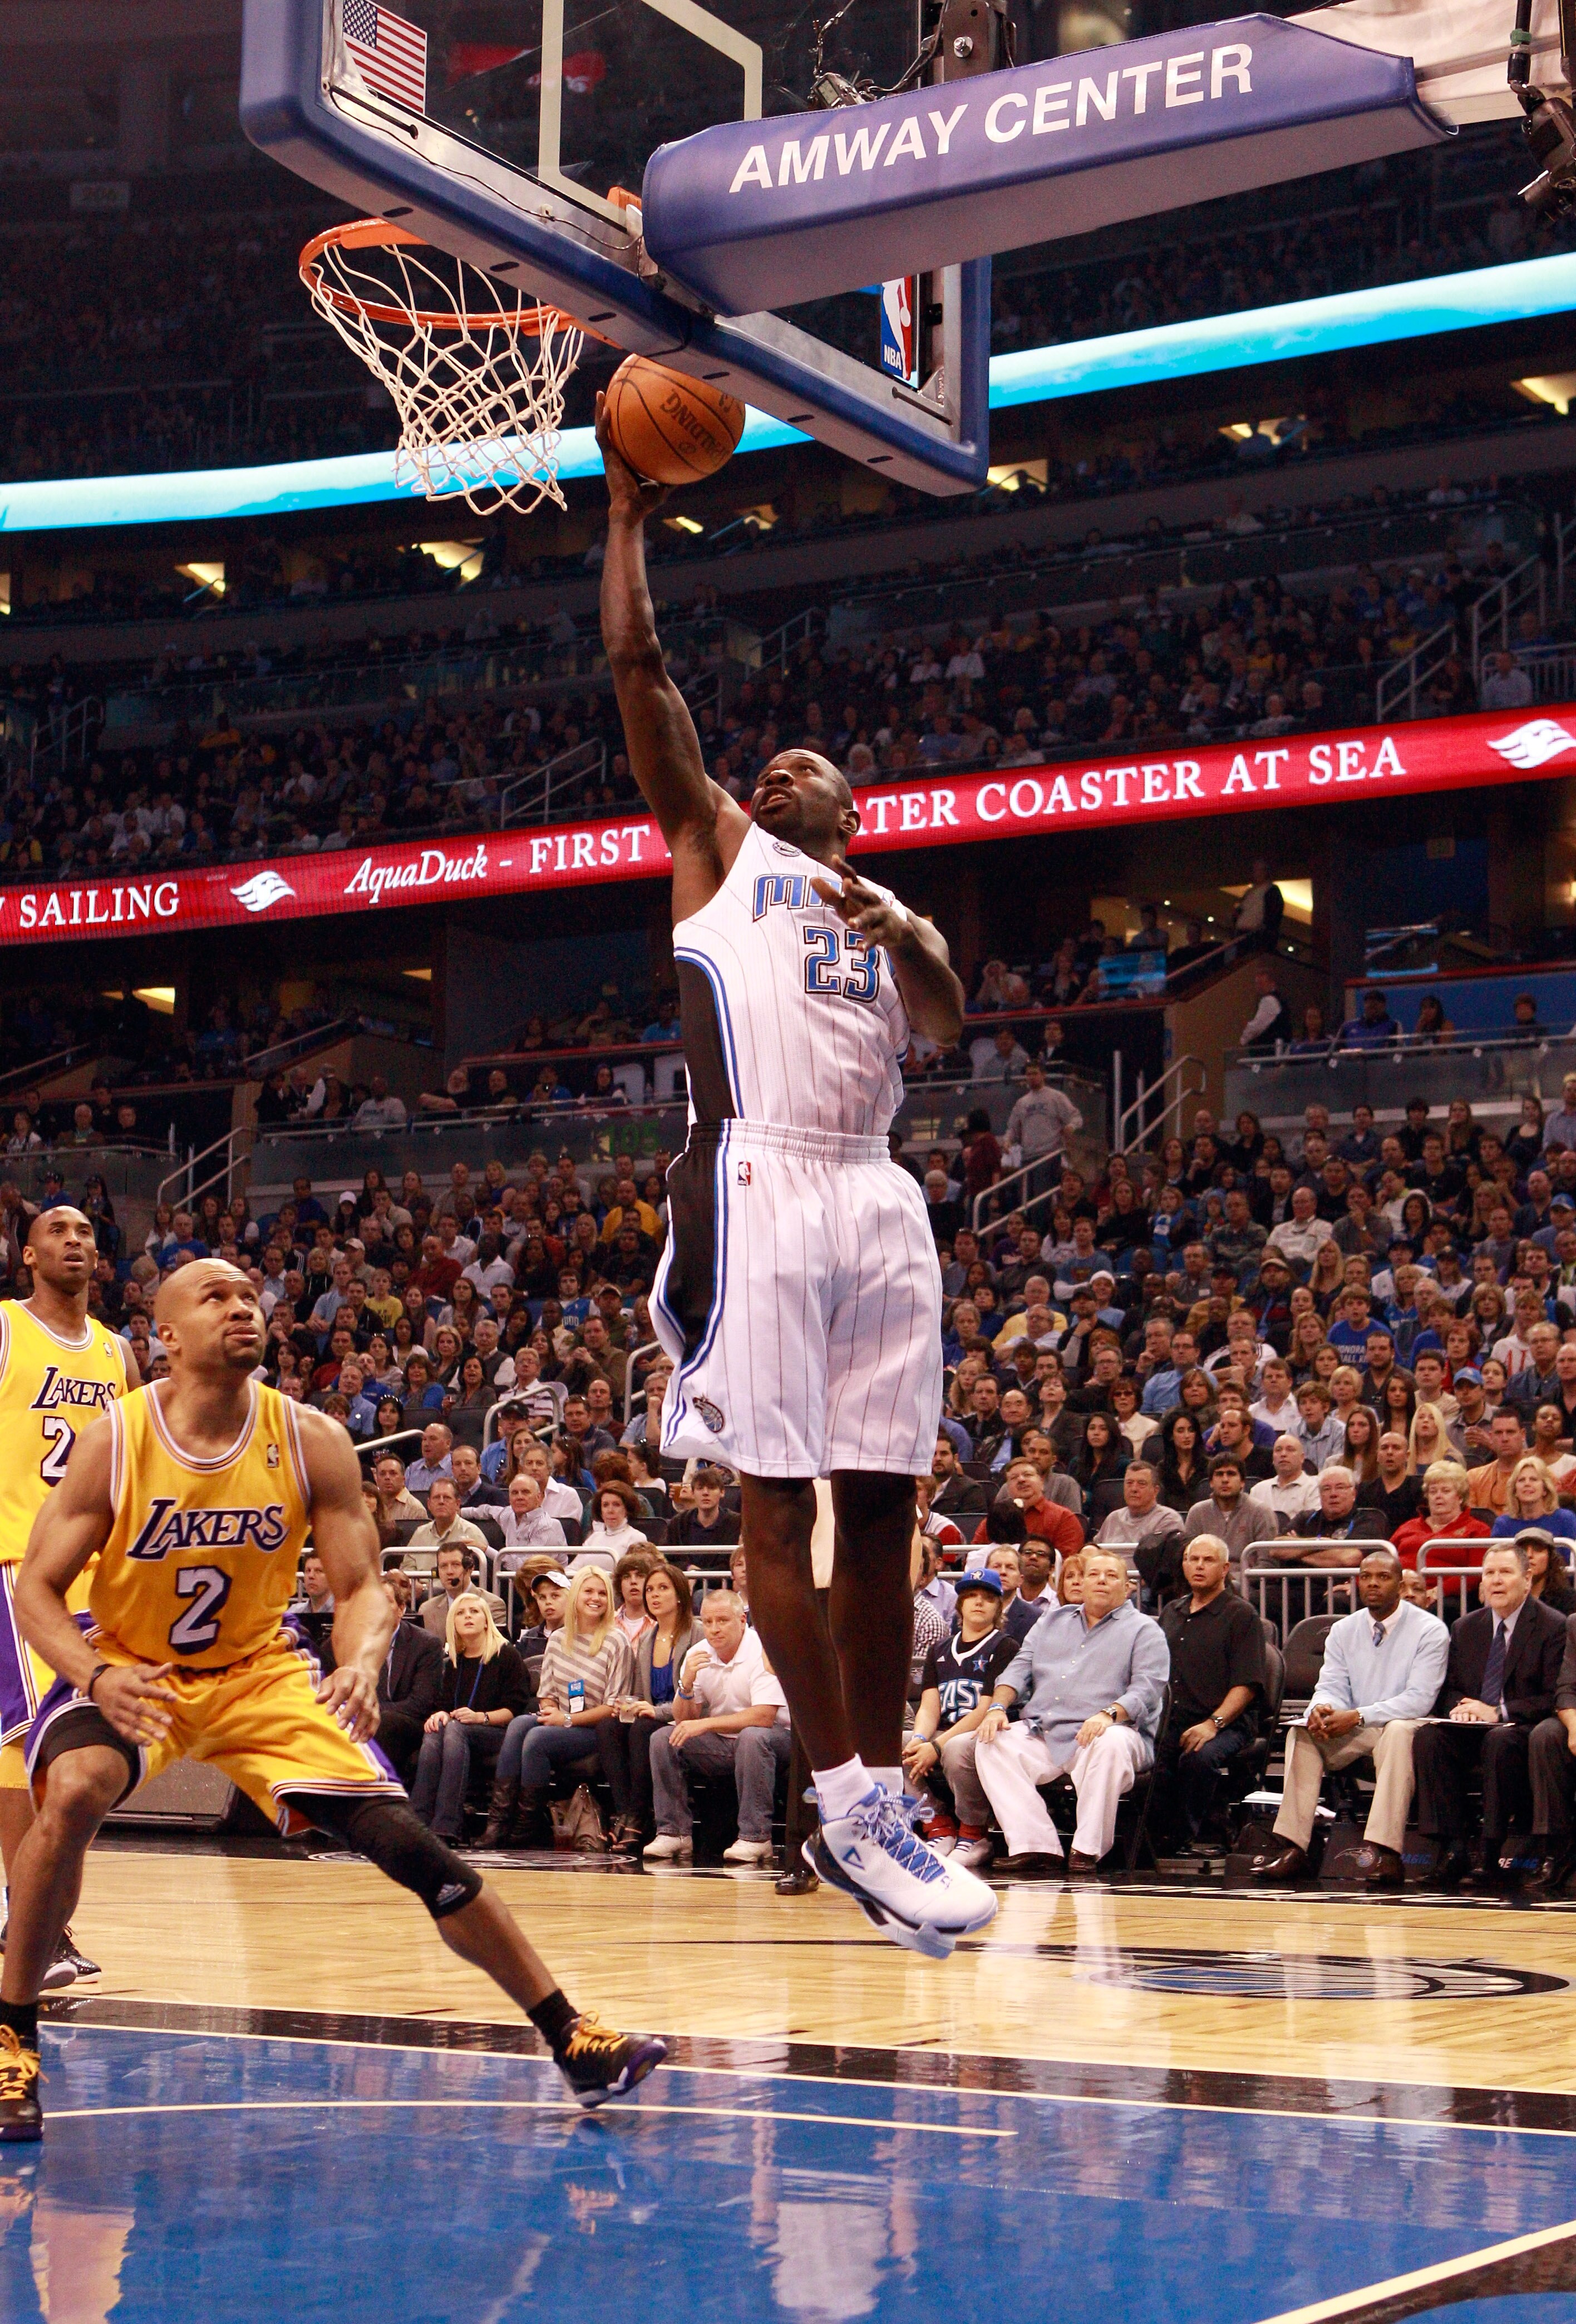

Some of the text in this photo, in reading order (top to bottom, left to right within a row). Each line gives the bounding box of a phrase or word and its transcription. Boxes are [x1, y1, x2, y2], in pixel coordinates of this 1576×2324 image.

[729, 43, 1253, 193] AMWAY CENTER
[884, 344, 902, 370] NBA
[344, 845, 487, 904] AquaDuck
[529, 825, 651, 873] FIRST
[976, 760, 1204, 822] COASTER
[1220, 749, 1289, 795] AT
[1309, 737, 1407, 785] SEA
[19, 882, 179, 928] SAILING
[804, 926, 880, 1003] 23
[30, 1366, 116, 1410] LAKERS
[125, 1497, 290, 1562] LAKERS
[168, 1565, 233, 1656] 2
